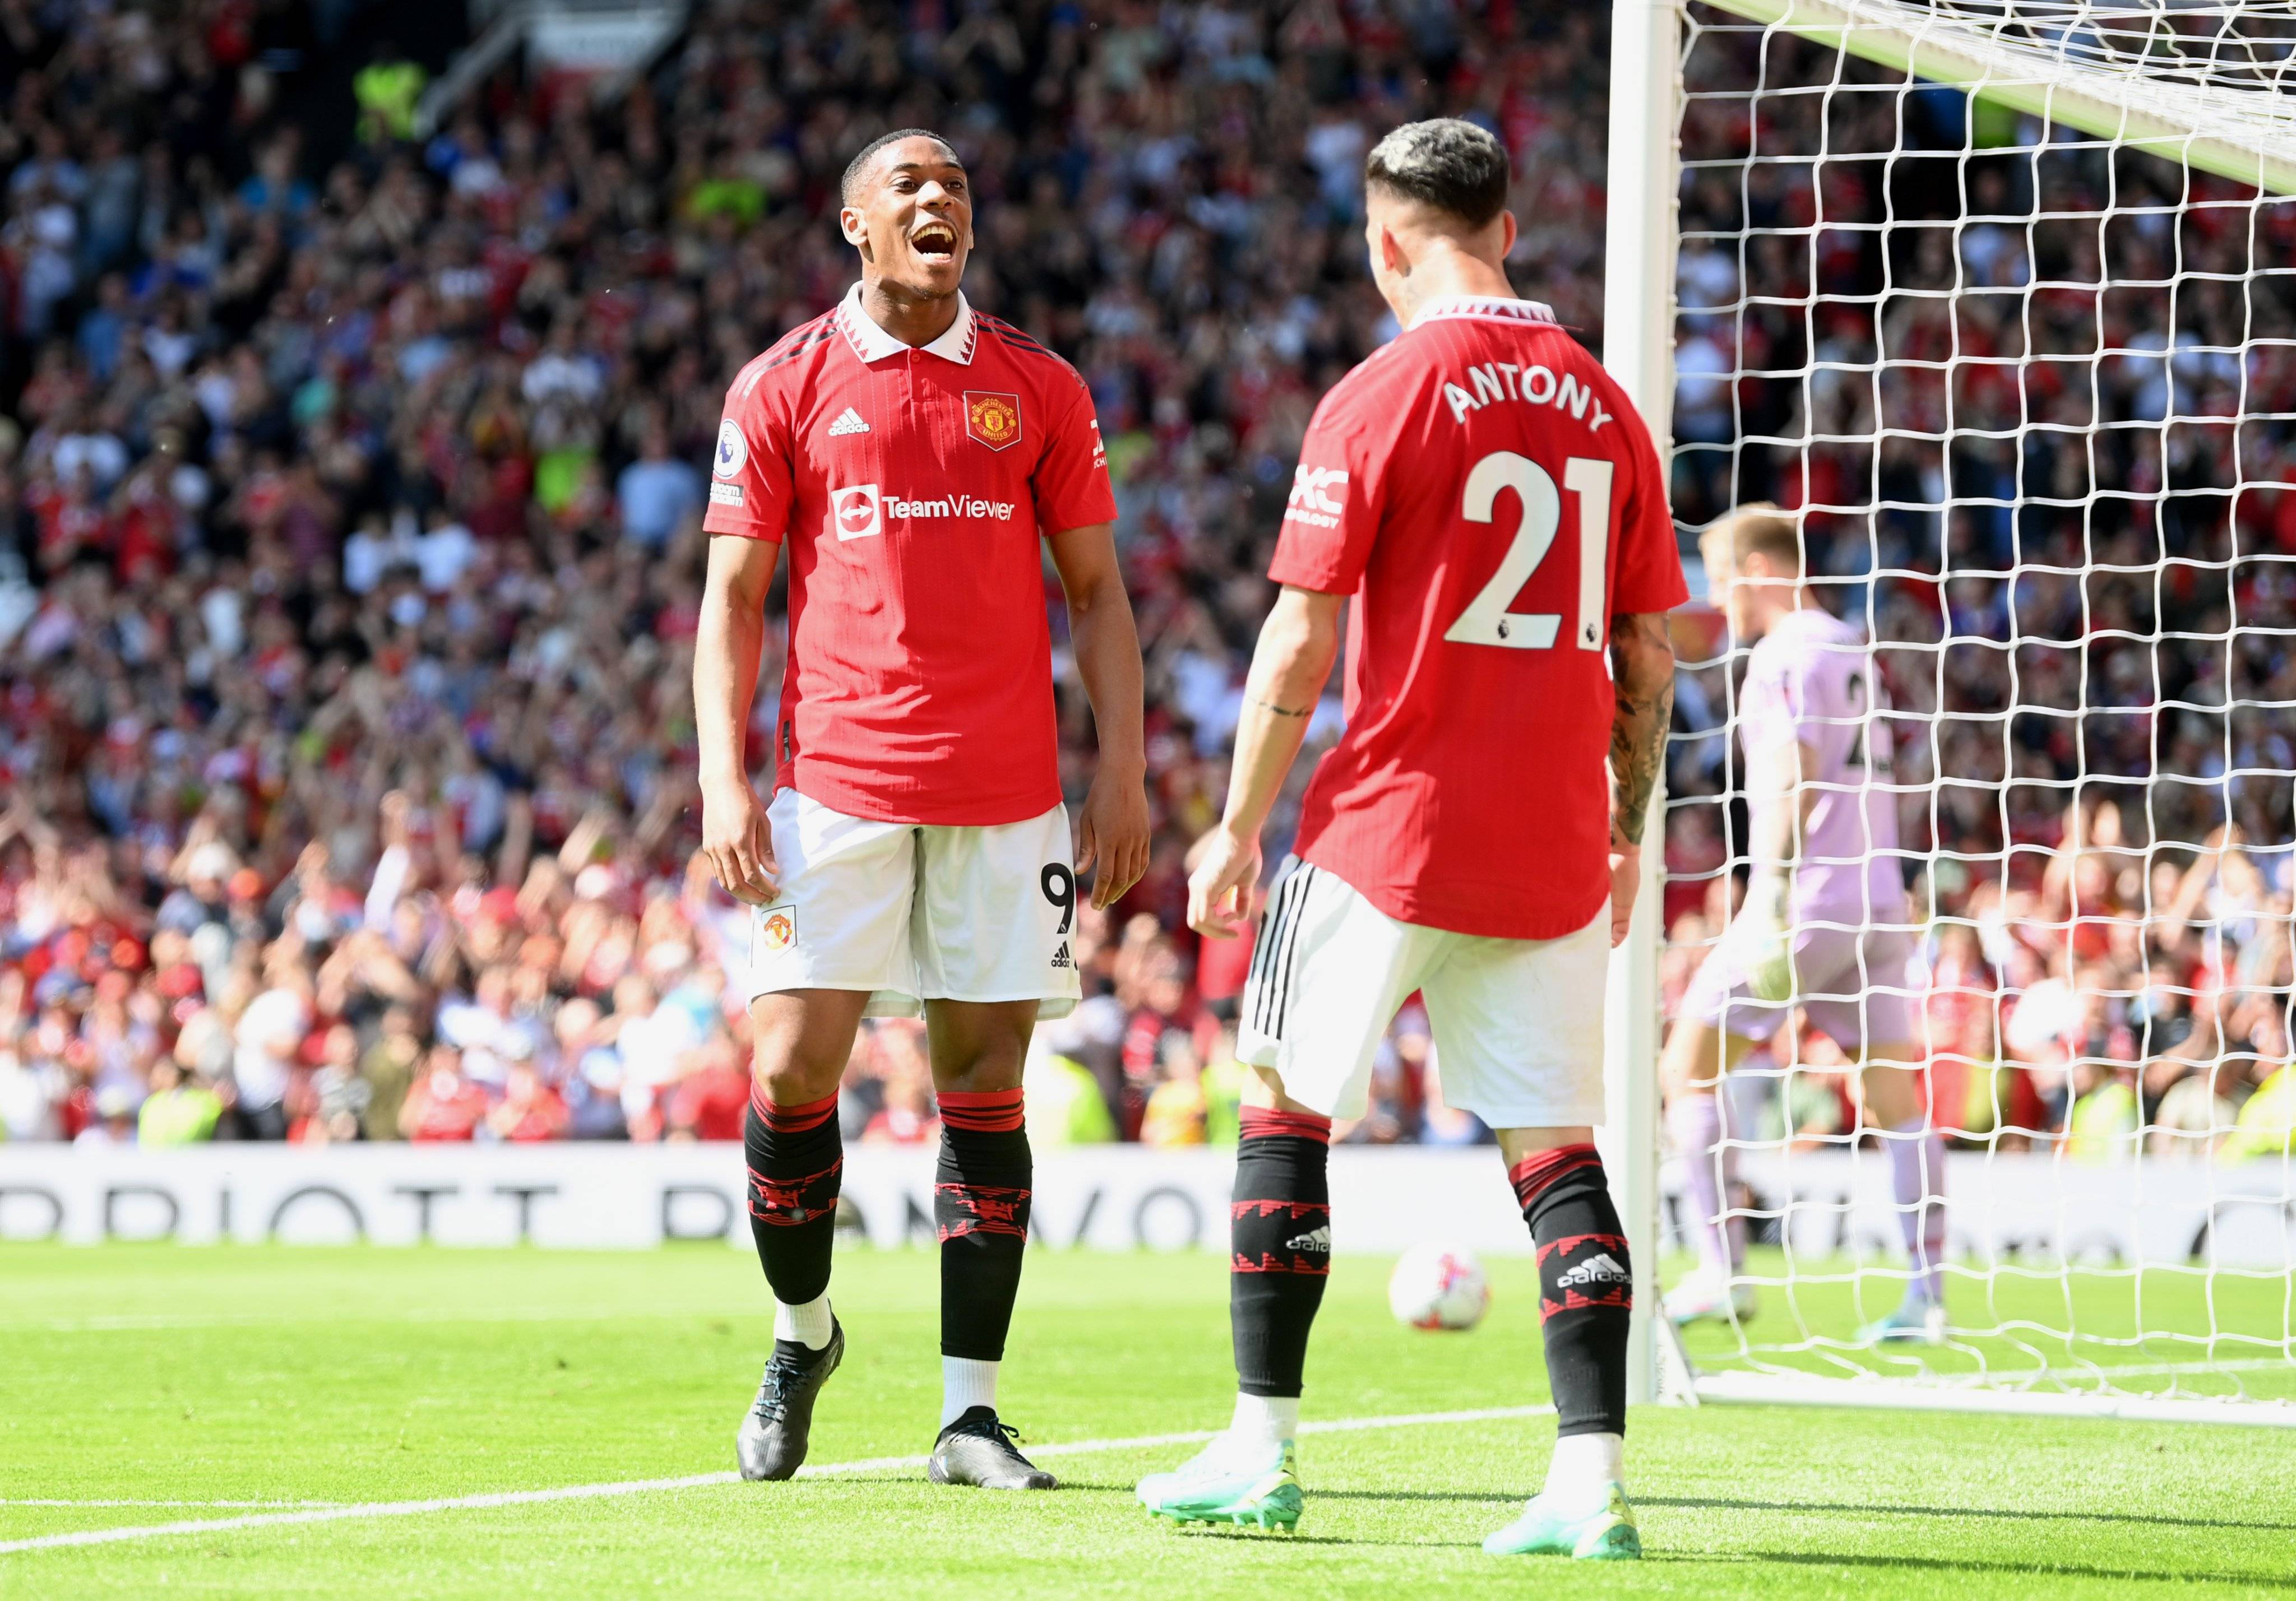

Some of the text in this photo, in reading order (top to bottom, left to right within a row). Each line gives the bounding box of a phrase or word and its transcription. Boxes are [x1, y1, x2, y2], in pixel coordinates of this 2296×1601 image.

[976, 400, 1012, 416] MANCHESTER
[1443, 362, 1614, 433] ANTONY
[828, 423, 871, 437] adidas
[982, 429, 1008, 438] UNITED
[882, 494, 1015, 521] TeamViewer
[1443, 449, 1614, 652] 21
[1041, 862, 1075, 934] 9
[1557, 1269, 1633, 1288] adidas
